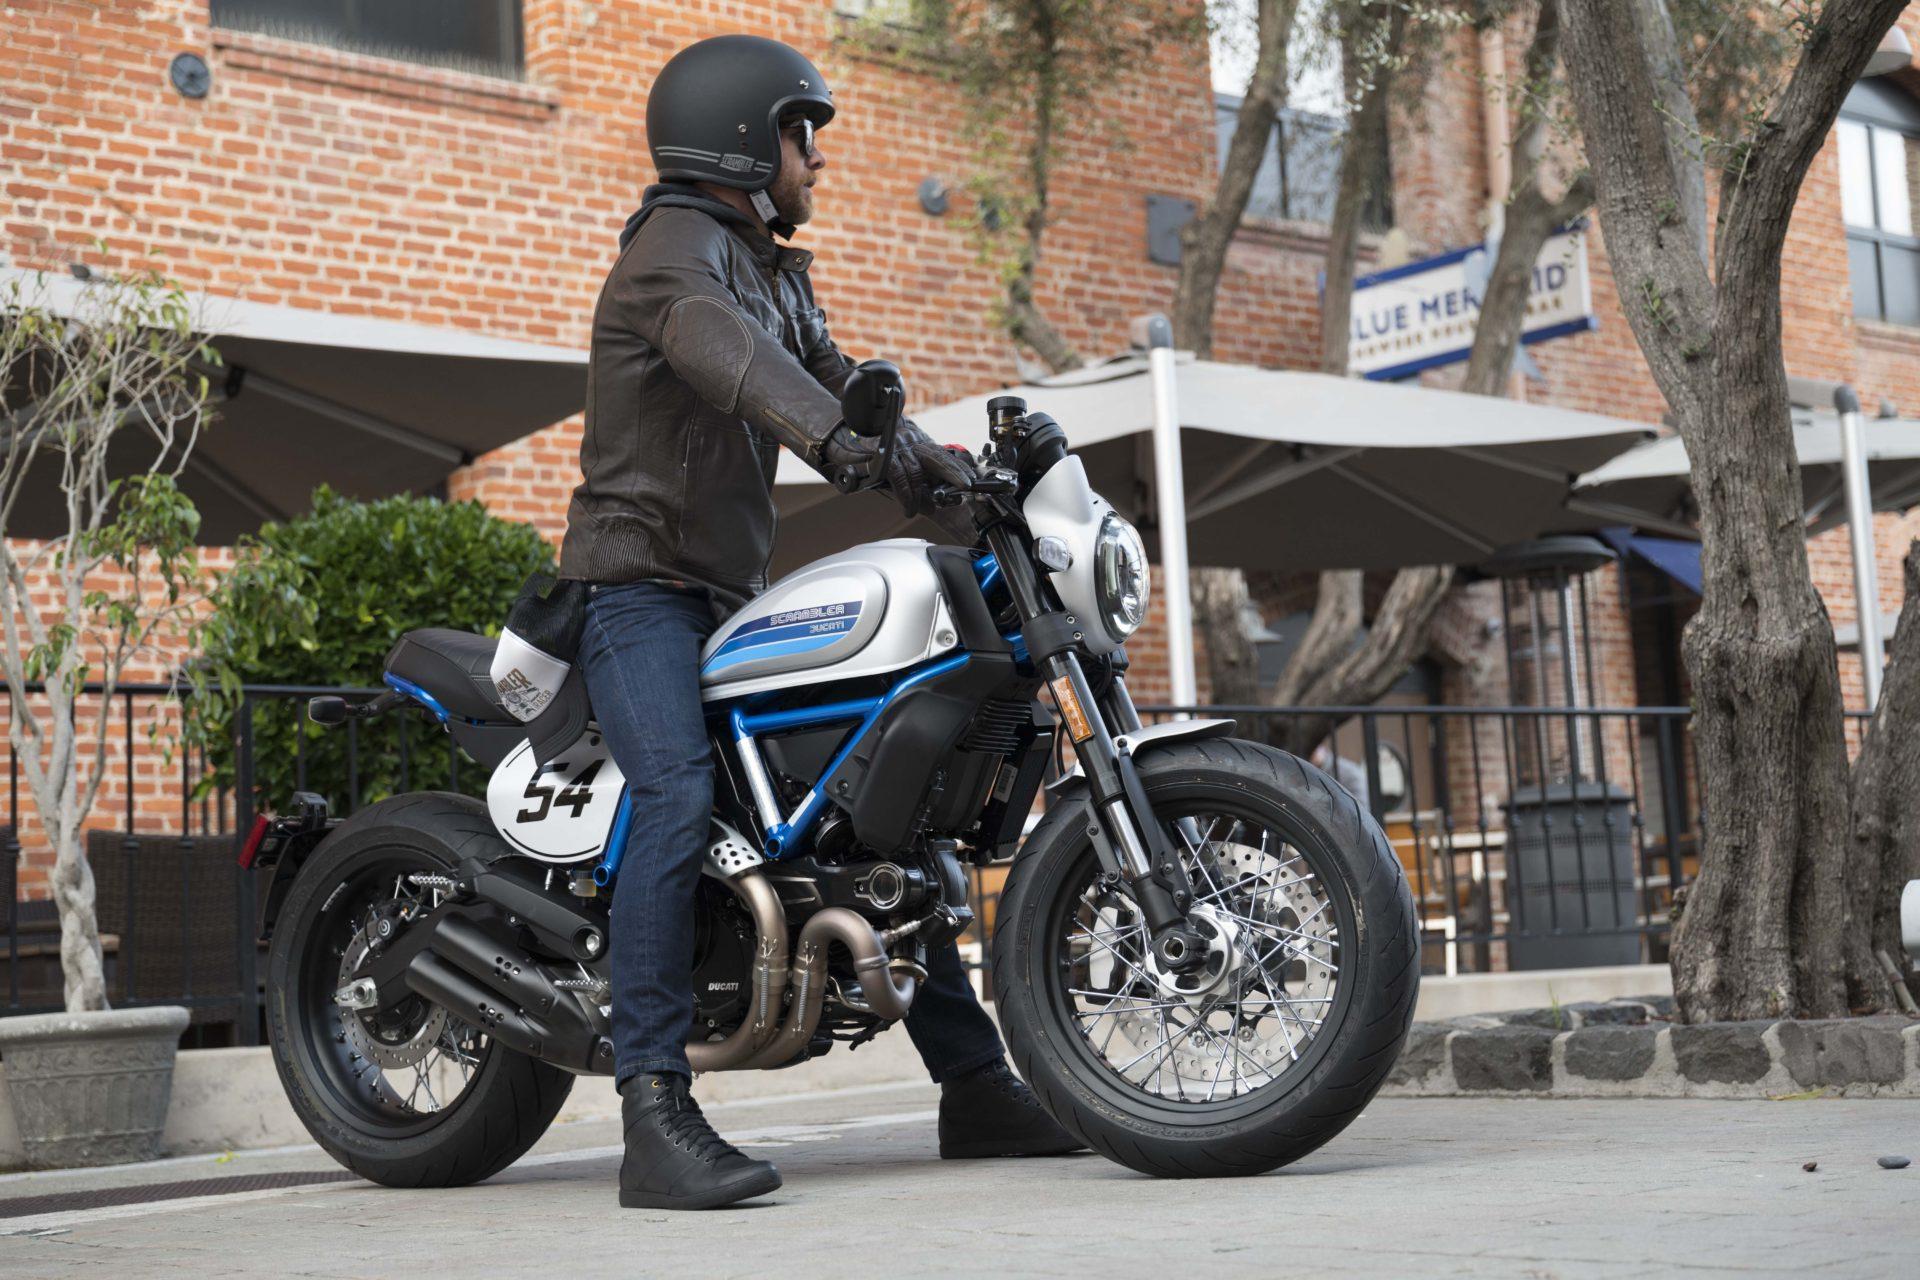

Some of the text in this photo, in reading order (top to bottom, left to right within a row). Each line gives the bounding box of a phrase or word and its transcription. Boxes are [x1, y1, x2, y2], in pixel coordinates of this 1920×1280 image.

[1352, 303, 1410, 341] LUE
[770, 604, 845, 626] SCRAMBLER
[809, 621, 845, 634] DUCATI
[516, 759, 606, 823] 54
[707, 982, 739, 991] DUCATI
